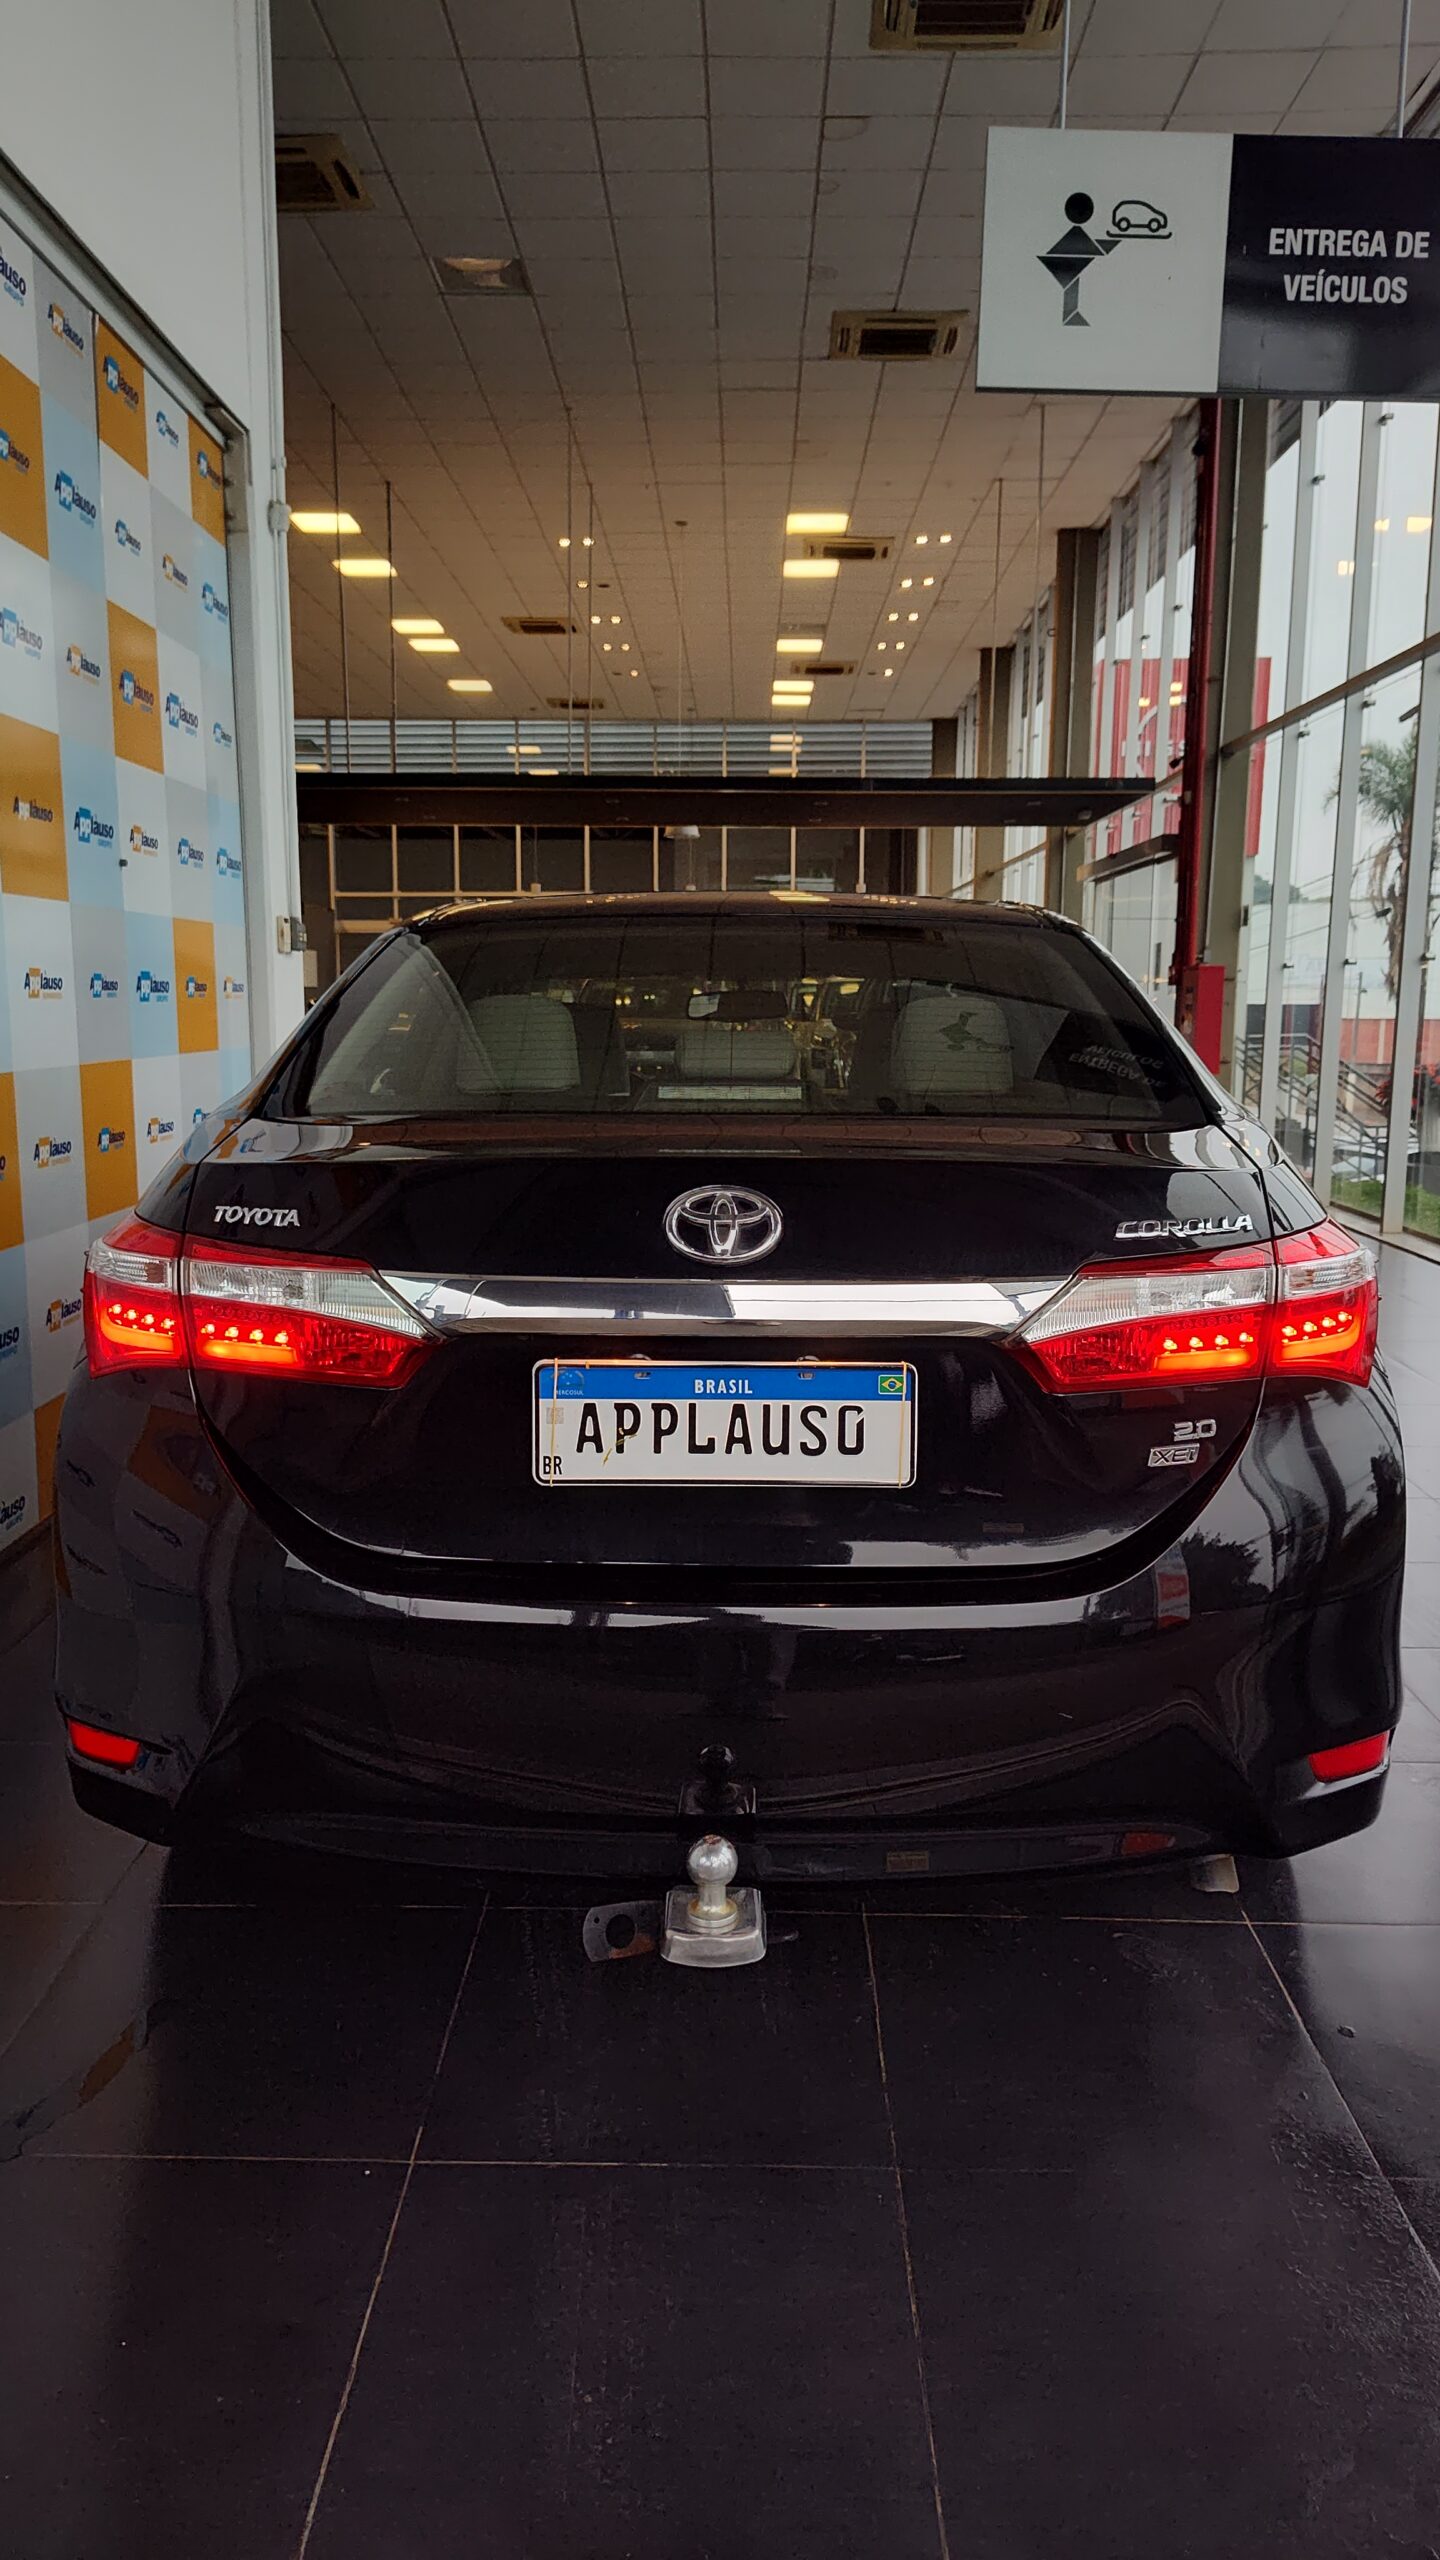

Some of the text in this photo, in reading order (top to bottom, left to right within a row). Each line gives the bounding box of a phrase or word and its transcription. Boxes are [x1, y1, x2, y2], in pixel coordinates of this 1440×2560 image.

[1268, 228, 1430, 258] ENTREGA DE
[1283, 269, 1408, 304] VEÍCULOS
[13, 796, 54, 822] Applauso
[73, 811, 115, 839] Applauso
[24, 972, 63, 995] Applauso
[136, 975, 170, 997] Applauso
[33, 1140, 72, 1165] Applauso
[213, 1205, 300, 1227] TOYOTA
[1114, 1214, 1254, 1241] COROLLA
[694, 1379, 753, 1394] BRASIL
[543, 1455, 562, 1475] BR
